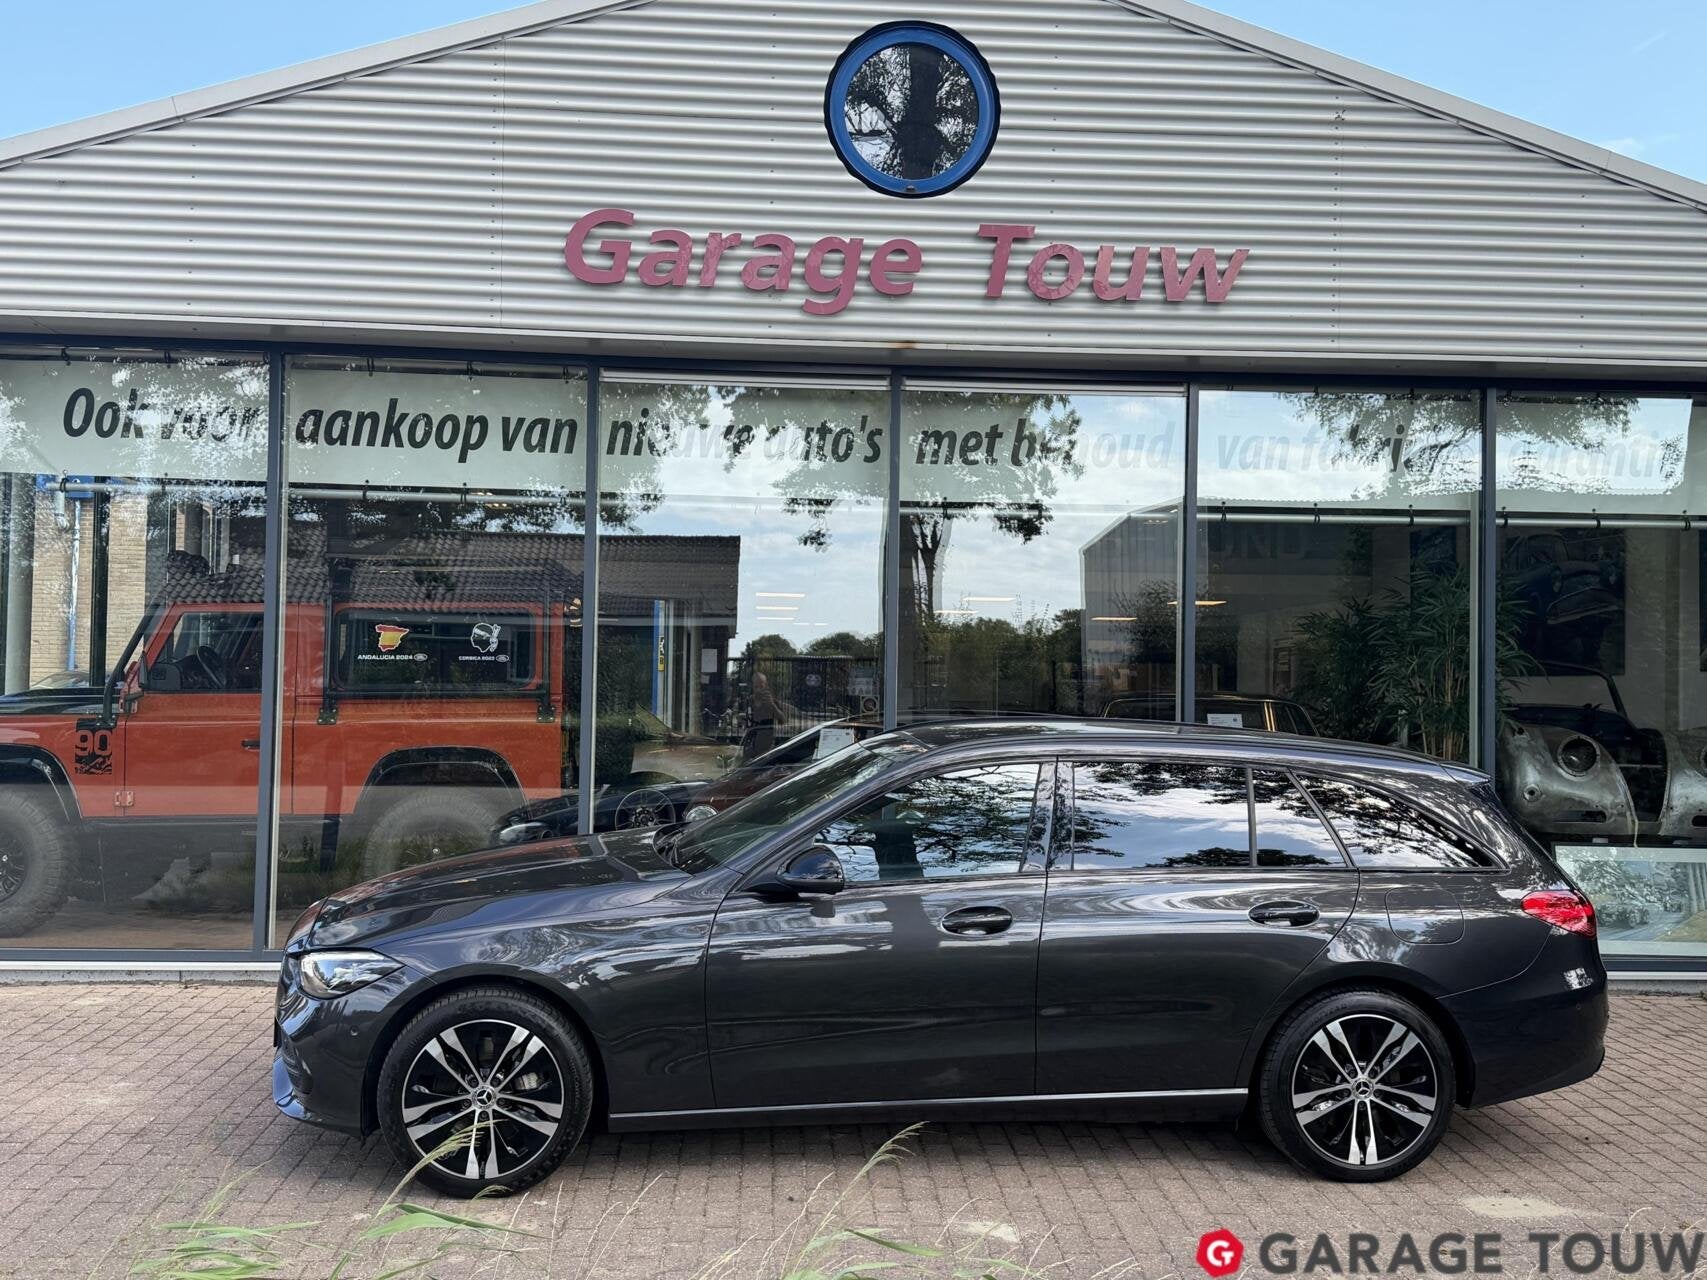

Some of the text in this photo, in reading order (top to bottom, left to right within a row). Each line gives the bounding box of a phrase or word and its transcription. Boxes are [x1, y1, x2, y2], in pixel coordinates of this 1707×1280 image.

[564, 208, 1251, 315] Garage Touw
[63, 386, 150, 440] Ook
[294, 397, 490, 464] aankoop
[501, 414, 579, 455] van
[914, 422, 1004, 467] met
[1216, 433, 1291, 472] van
[74, 728, 113, 757] 90
